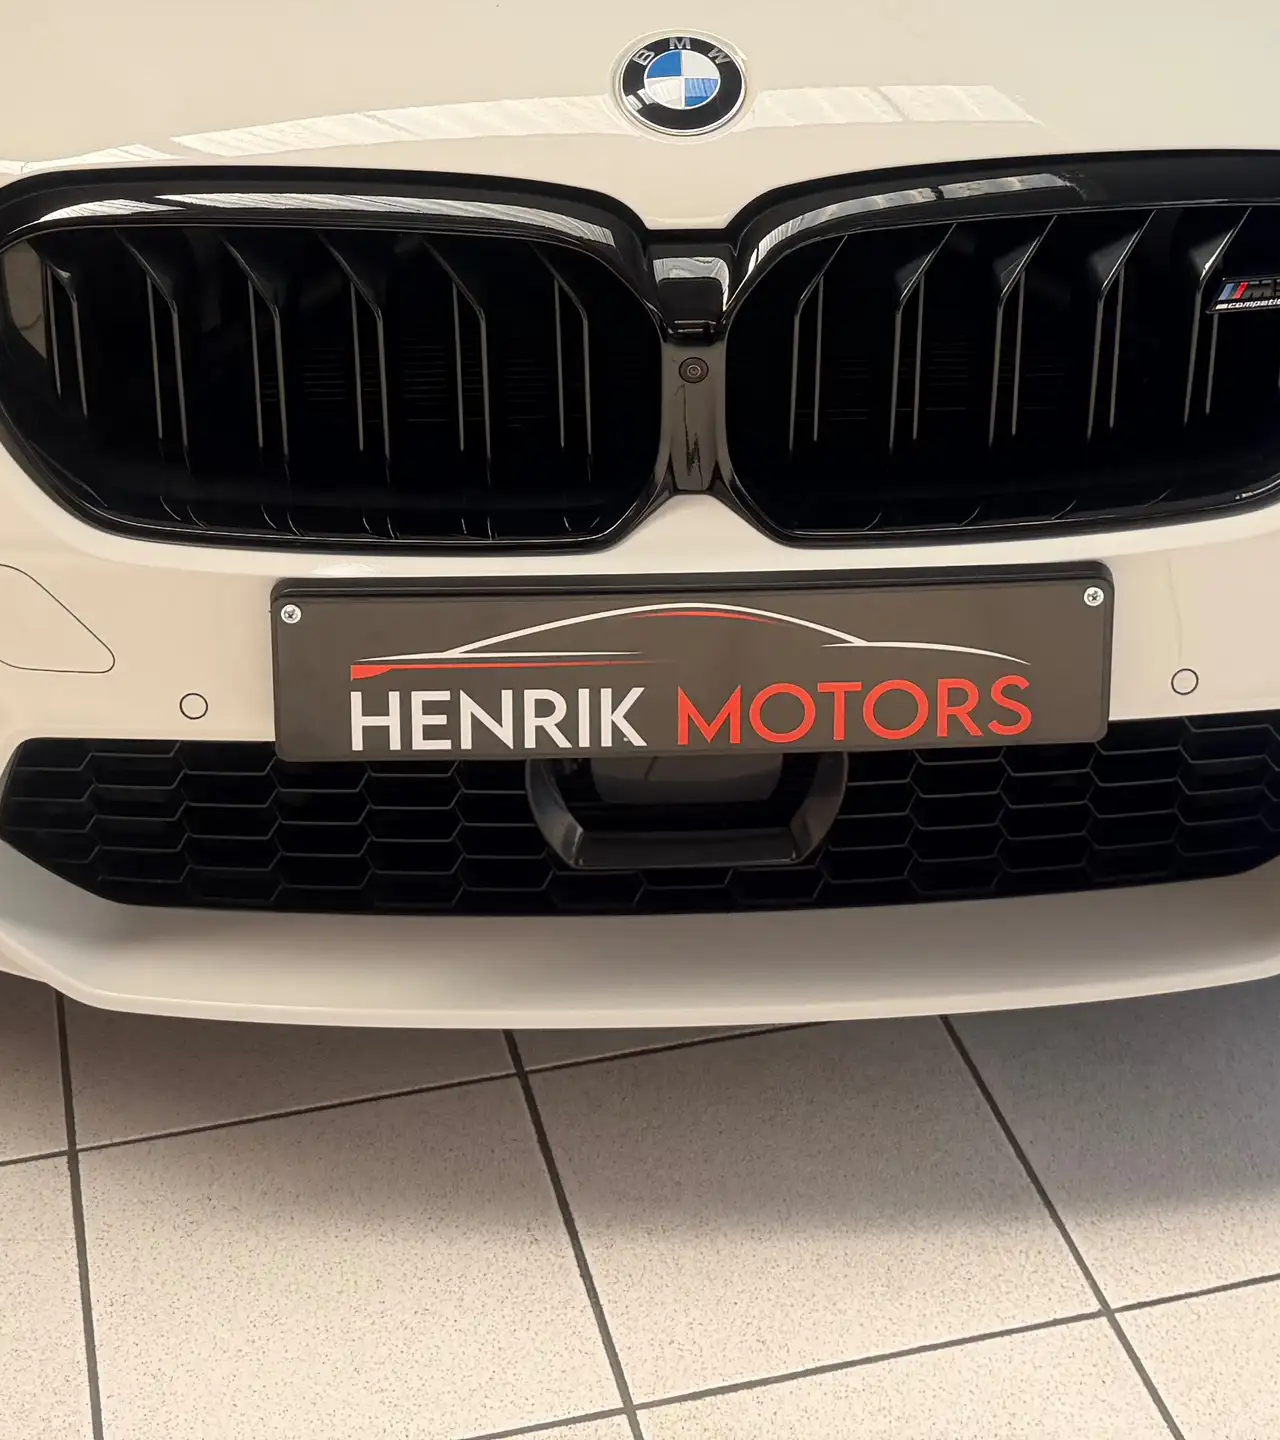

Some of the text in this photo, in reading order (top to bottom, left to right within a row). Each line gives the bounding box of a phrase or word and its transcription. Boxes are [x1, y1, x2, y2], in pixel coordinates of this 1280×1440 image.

[631, 36, 732, 66] BMW
[350, 673, 1034, 752] HENRIK MOTORS
